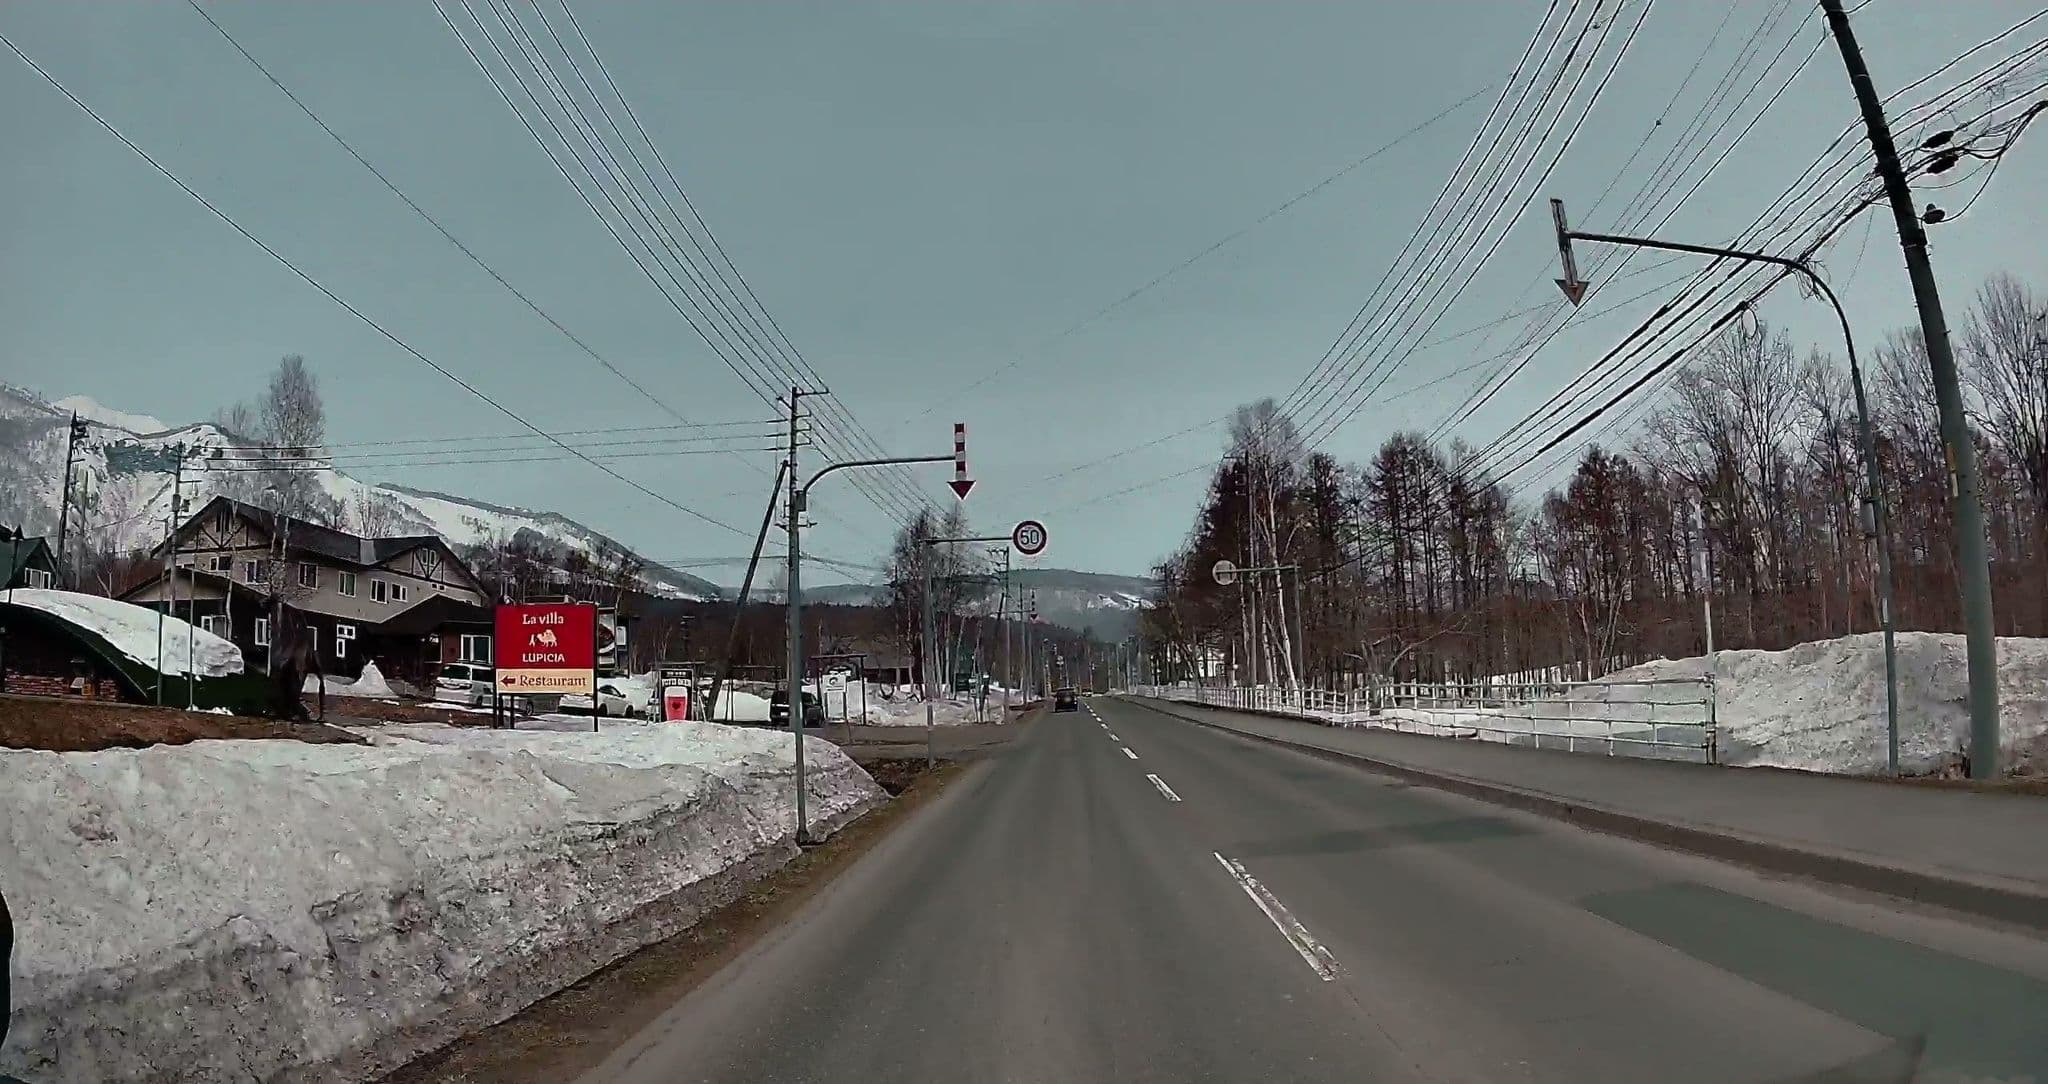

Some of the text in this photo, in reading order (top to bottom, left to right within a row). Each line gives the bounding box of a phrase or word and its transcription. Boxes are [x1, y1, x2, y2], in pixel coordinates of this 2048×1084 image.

[1020, 529, 1039, 545] 50
[522, 611, 564, 625] La villa
[522, 653, 565, 663] LUPICIA
[519, 674, 586, 687] Restaurant
